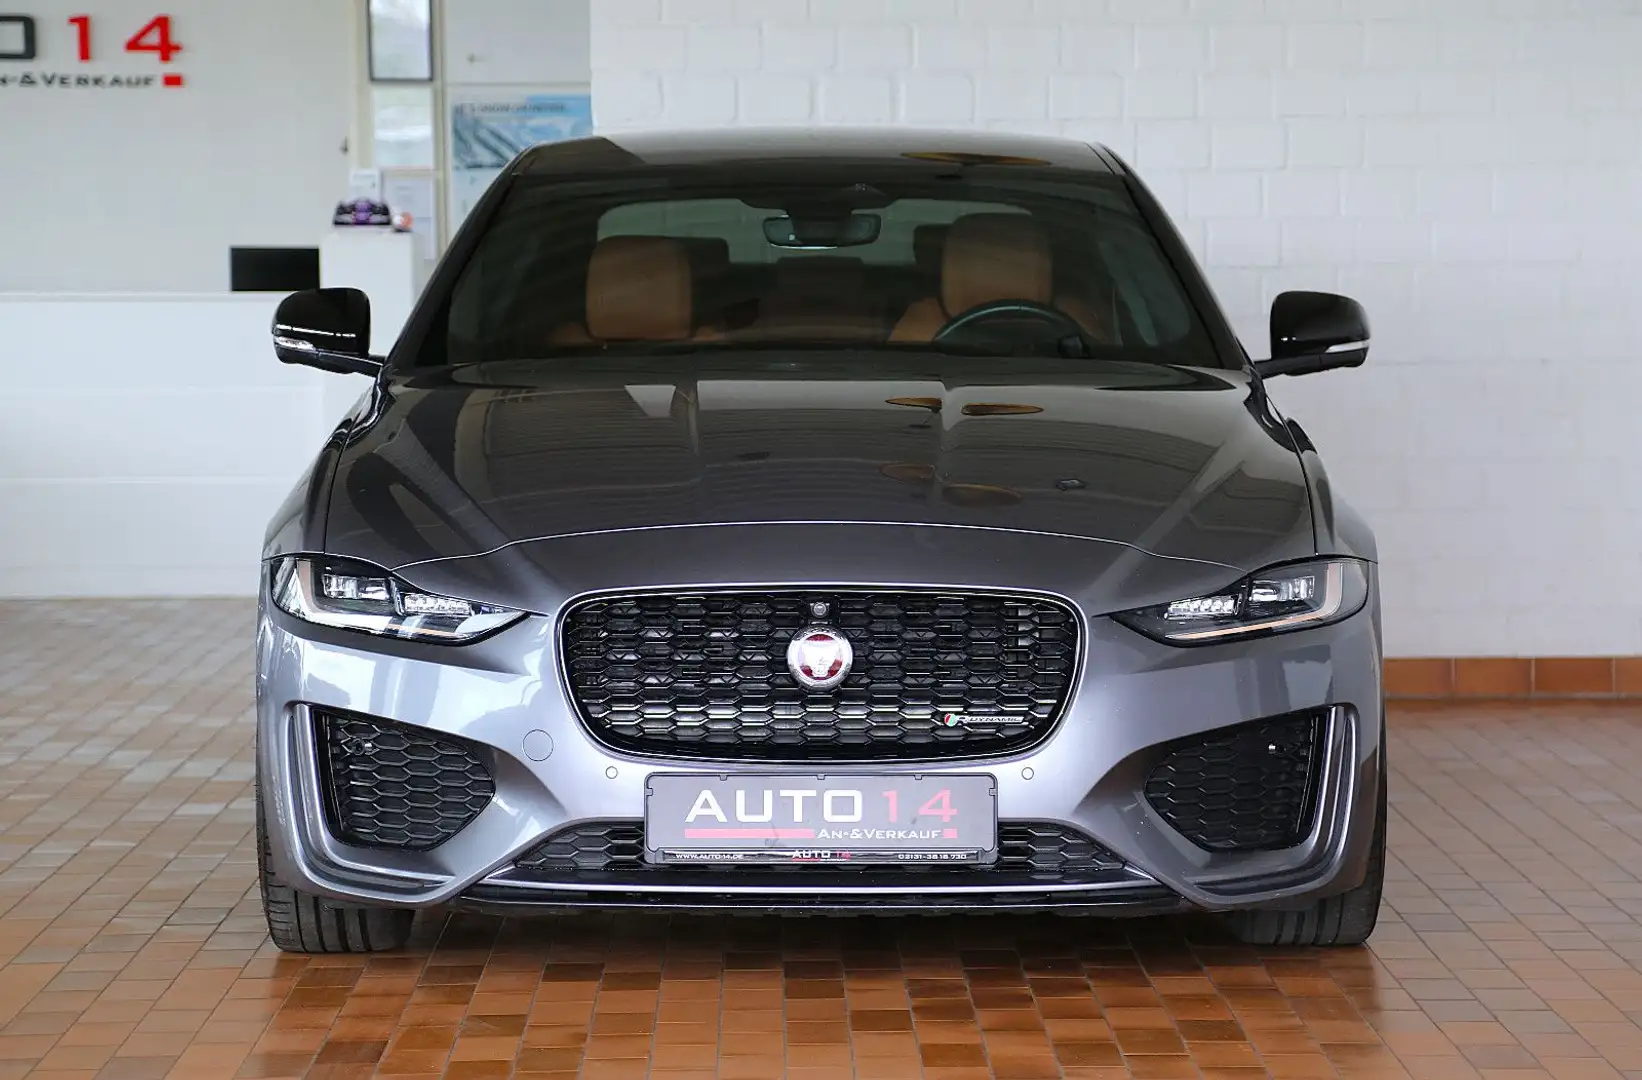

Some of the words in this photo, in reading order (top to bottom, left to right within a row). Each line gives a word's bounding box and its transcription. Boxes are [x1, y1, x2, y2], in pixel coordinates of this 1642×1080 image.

[67, 13, 184, 64] 14
[684, 789, 863, 823] AUTO
[881, 788, 958, 823] 14
[792, 850, 831, 859] AUTO
